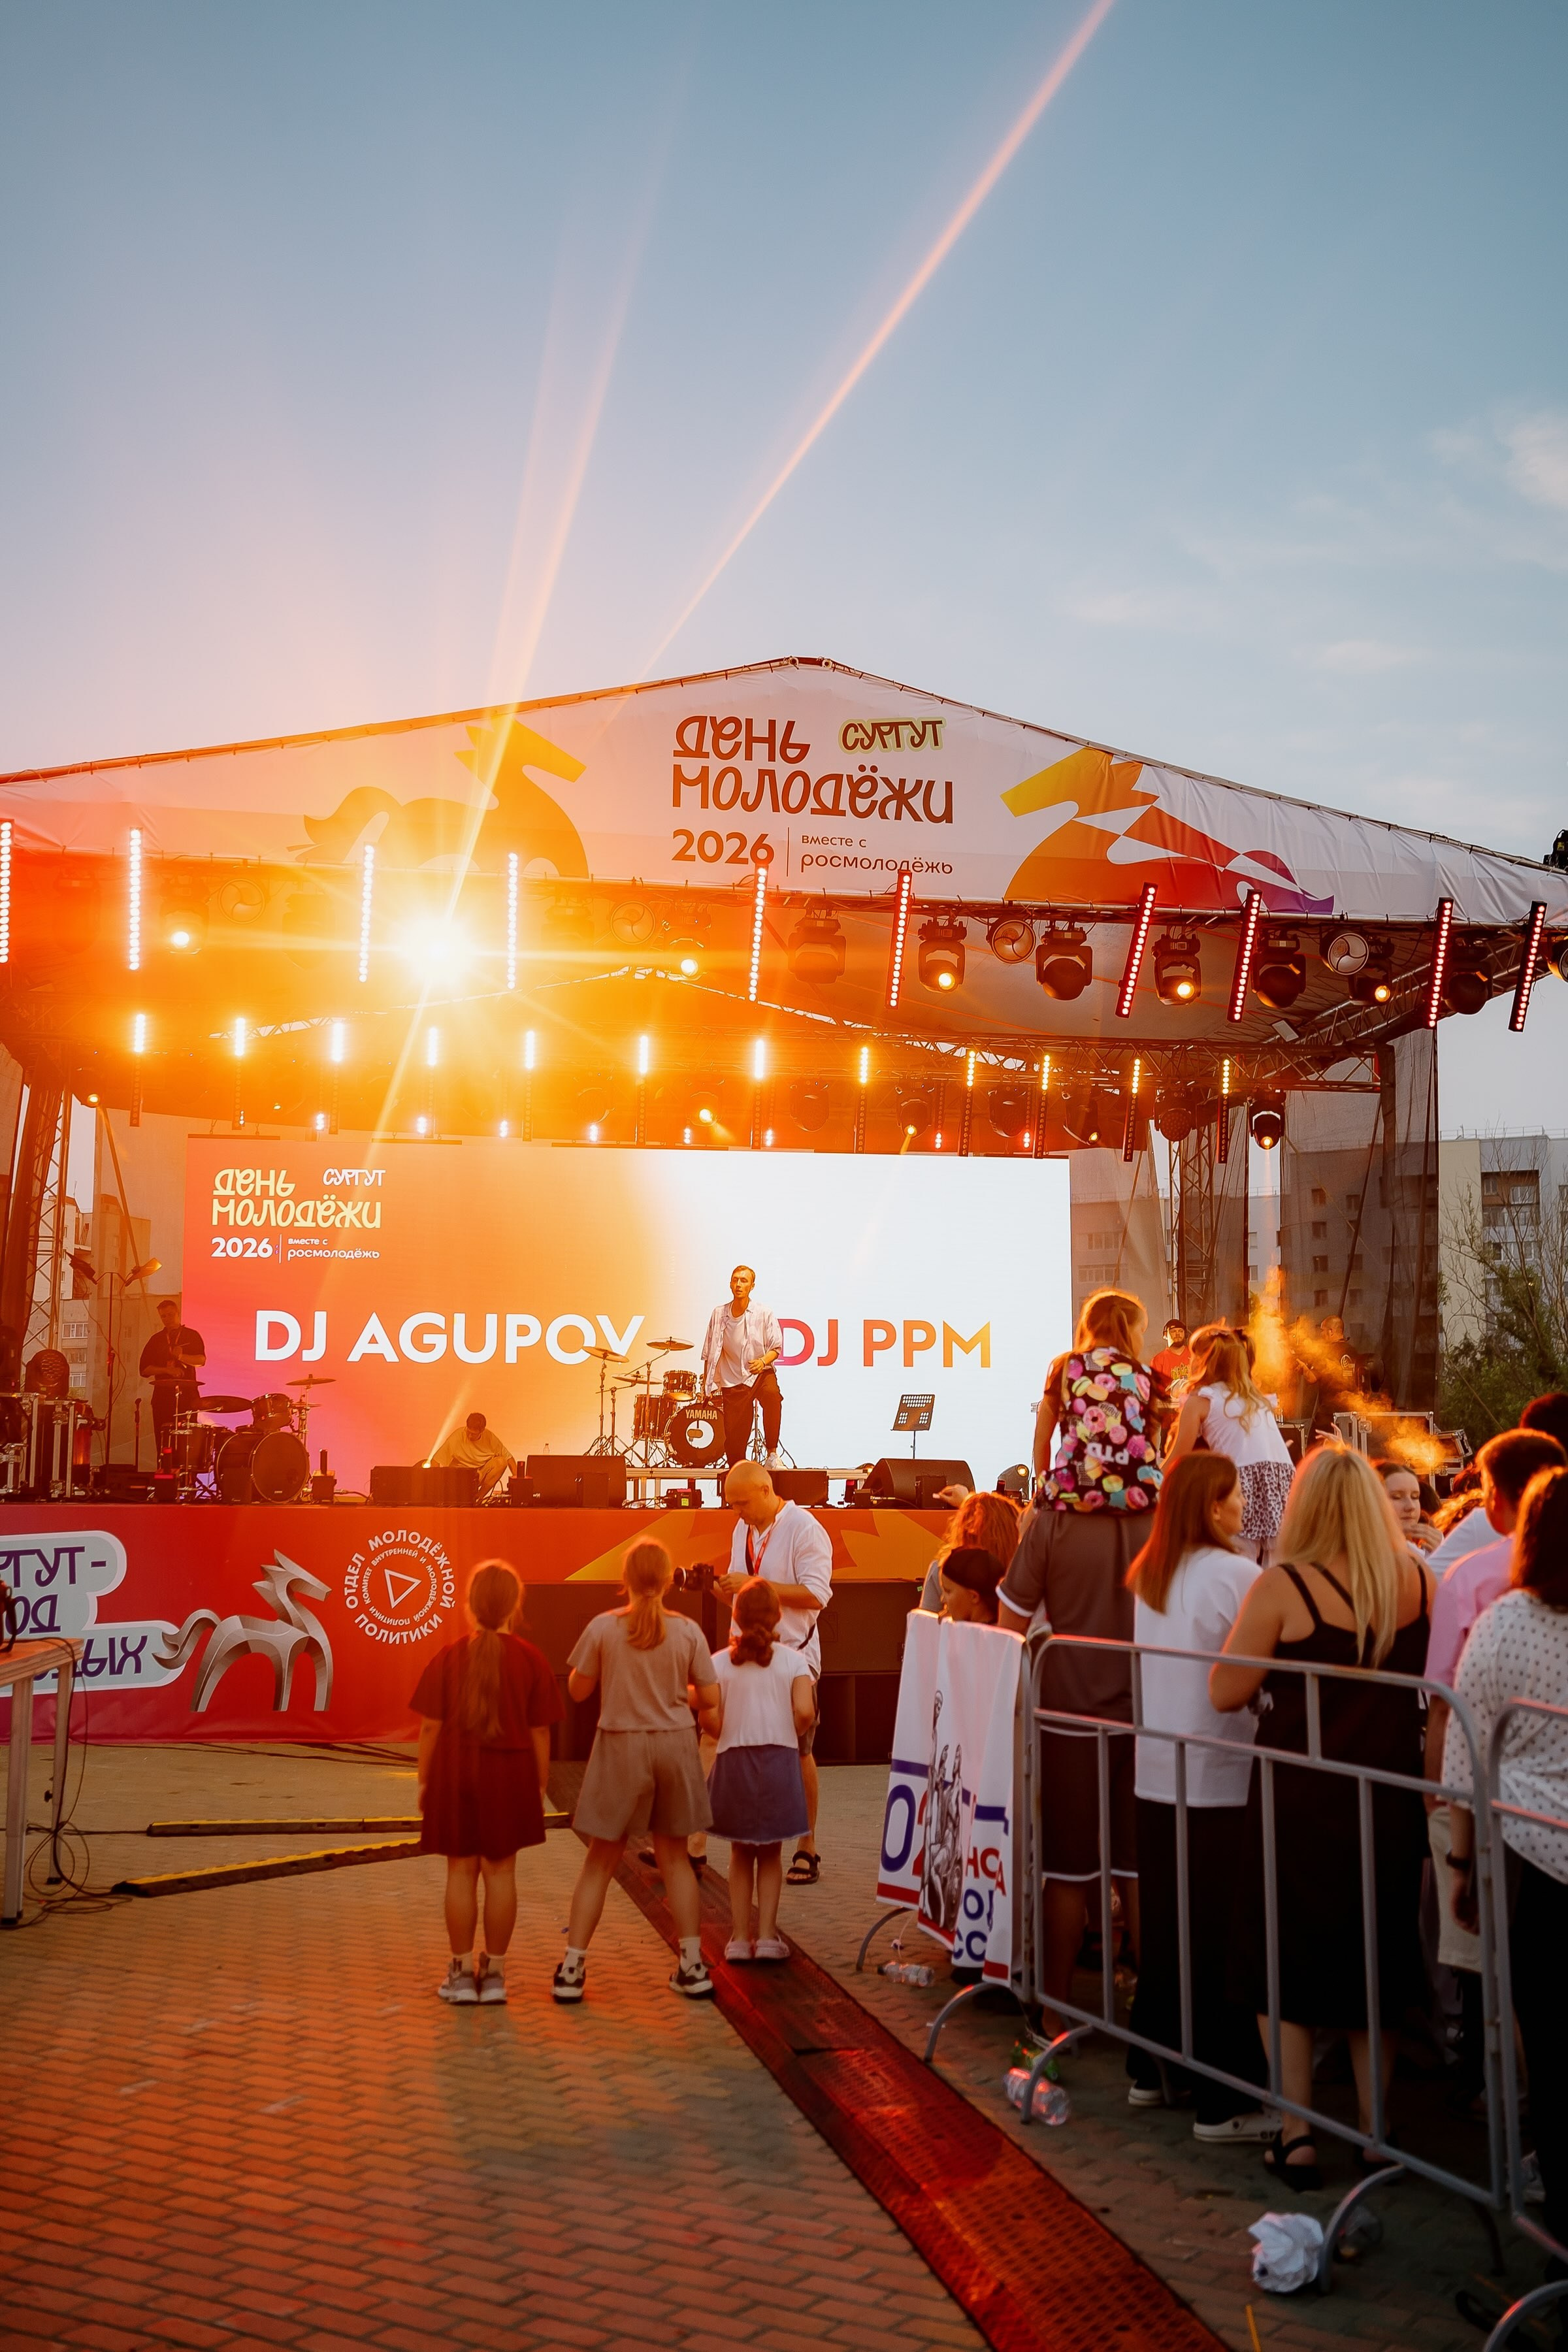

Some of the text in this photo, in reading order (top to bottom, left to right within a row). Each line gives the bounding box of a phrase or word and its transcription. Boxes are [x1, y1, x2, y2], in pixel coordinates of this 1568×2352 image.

[842, 720, 943, 751] СУРГУТ
[672, 829, 775, 865] 2026
[802, 835, 867, 848] вместе с
[801, 854, 953, 875] росмолодёжь
[323, 1168, 386, 1186] СУРГУТ
[211, 1237, 273, 1258] 2026
[287, 1248, 380, 1261] росмолодёжь
[254, 1310, 645, 1365] DJ AGUPOV
[774, 1318, 990, 1368] DJ PPM
[685, 1409, 717, 1420] YAMAHA
[371, 1547, 419, 1566] ВНУТРЕННЕЙ
[344, 1529, 455, 1644] ОТДЕЛ МОЛОДЁЖНОЙ ПОЛИТИКИ
[361, 1567, 372, 1605] КОМИТЕТ
[413, 1564, 437, 1622] МОЛОДЁЖНОЙ
[368, 1605, 410, 1626] ПОЛИТИКИ
